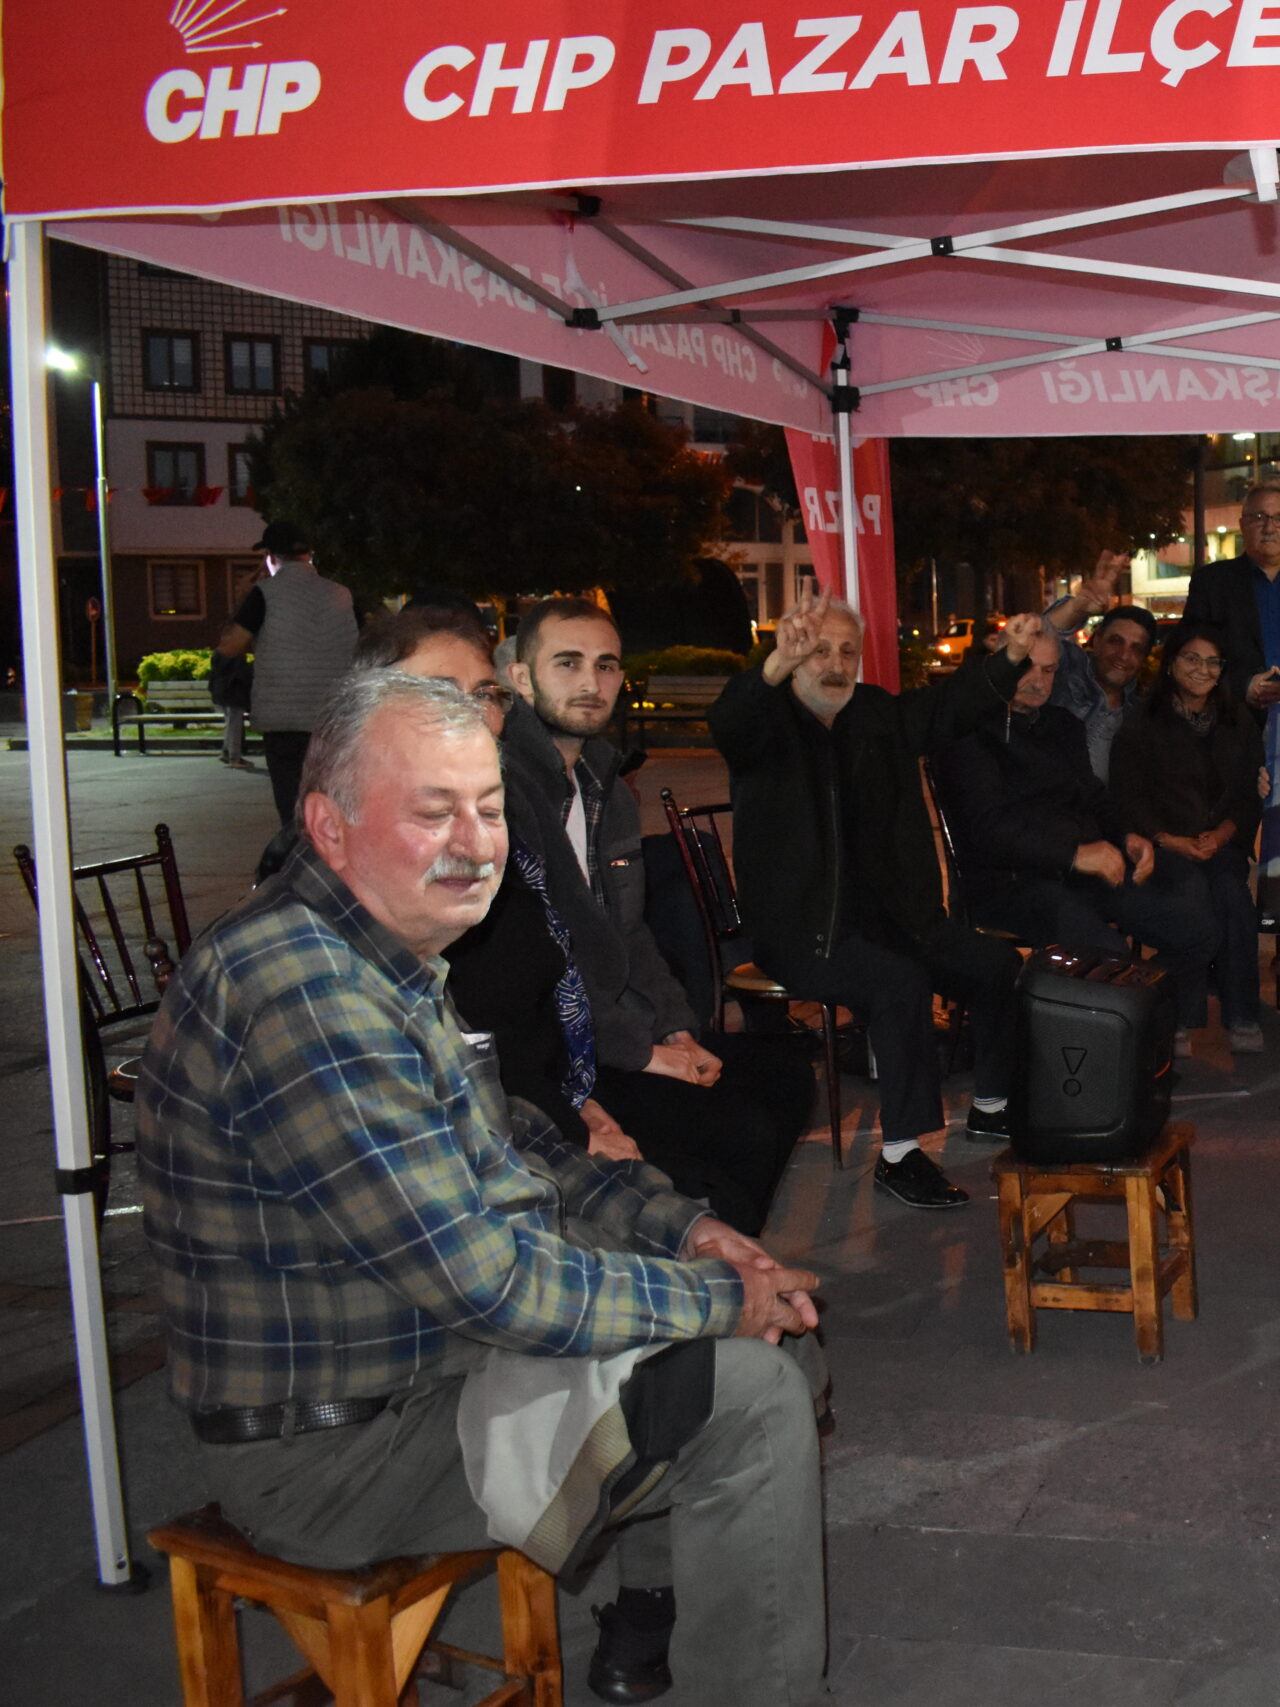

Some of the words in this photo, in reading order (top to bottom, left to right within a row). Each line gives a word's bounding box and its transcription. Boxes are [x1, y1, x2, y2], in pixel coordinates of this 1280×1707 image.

[145, 60, 321, 144] CHP
[404, 35, 616, 122] CHP
[638, 3, 1020, 105] PAZAR
